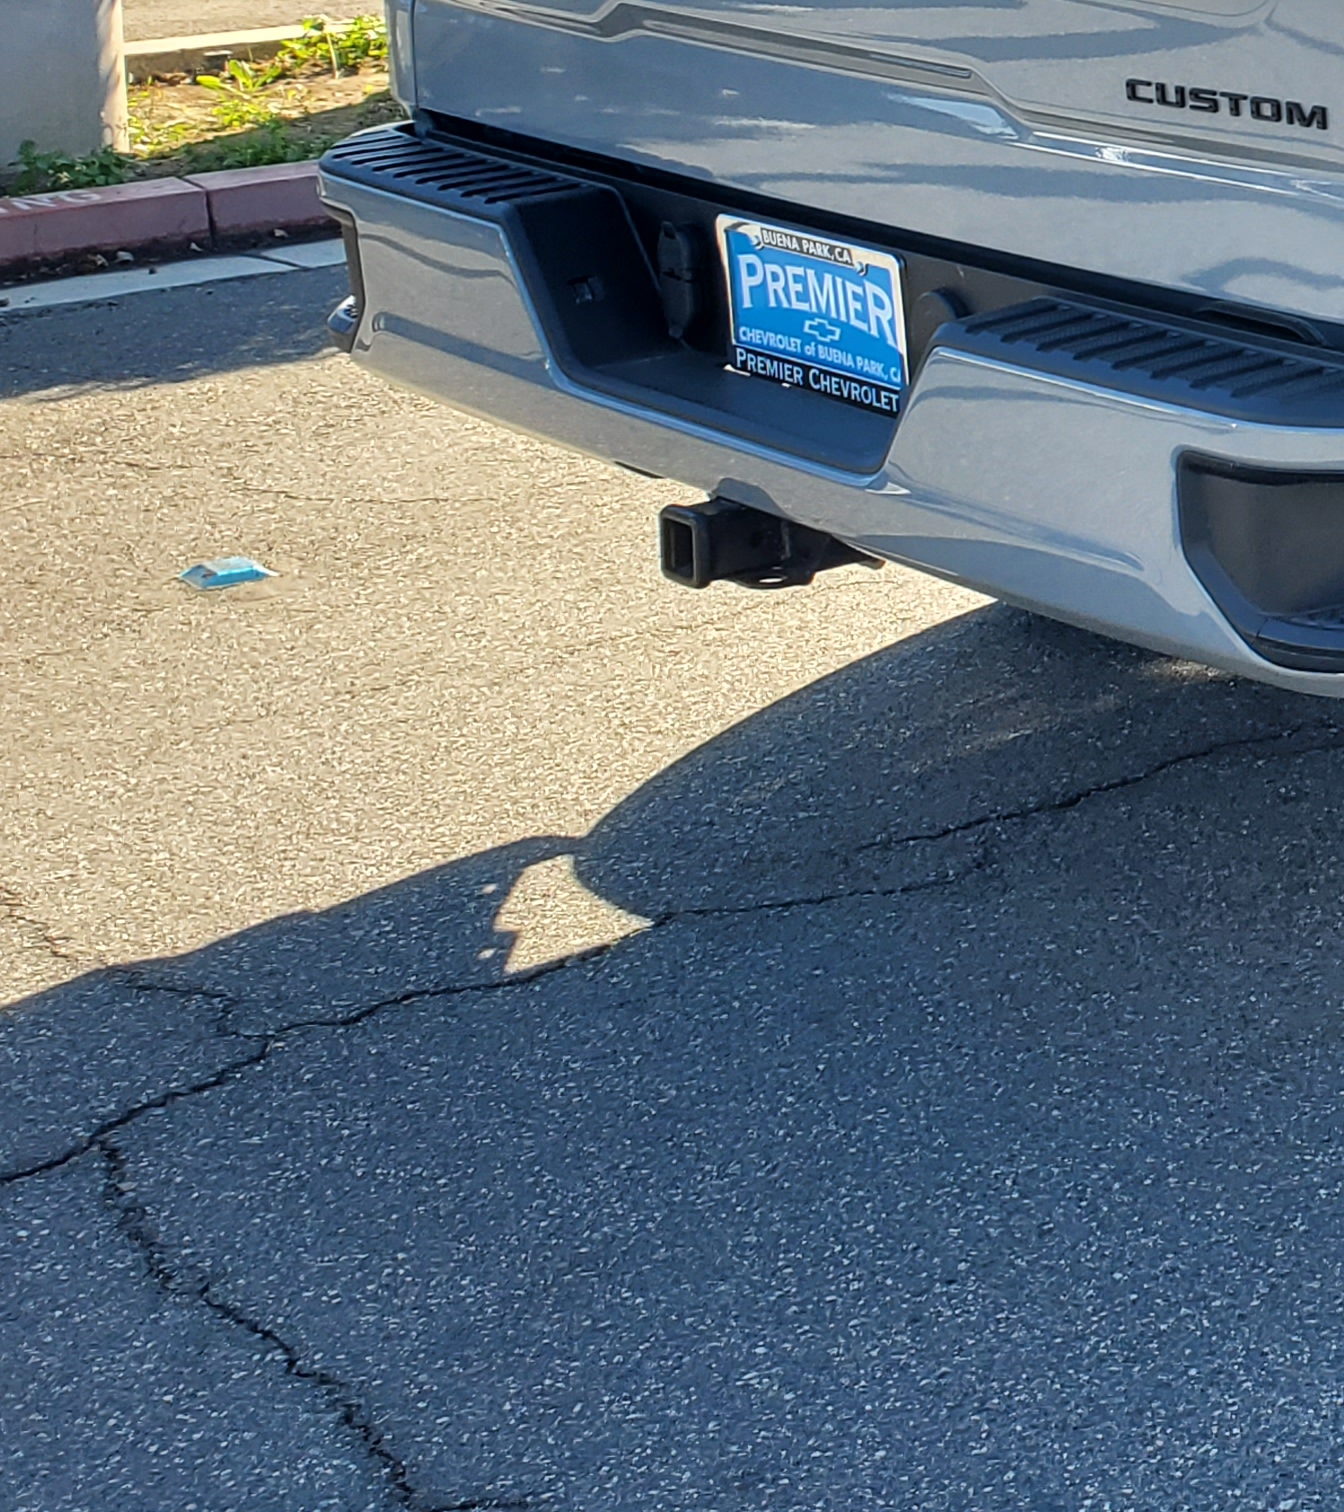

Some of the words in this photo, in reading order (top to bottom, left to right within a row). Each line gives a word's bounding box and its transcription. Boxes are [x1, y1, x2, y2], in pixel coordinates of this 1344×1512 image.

[1125, 78, 1329, 130] CUSTOM
[762, 229, 800, 251] BUENA
[737, 253, 899, 348] PREMIER
[736, 347, 804, 385] PREMIER
[808, 368, 899, 412] CHEVROLET
[739, 326, 802, 354] CHEVROLET
[804, 341, 815, 356] of
[818, 345, 854, 368] BUENA
[856, 355, 889, 381] PARK,
